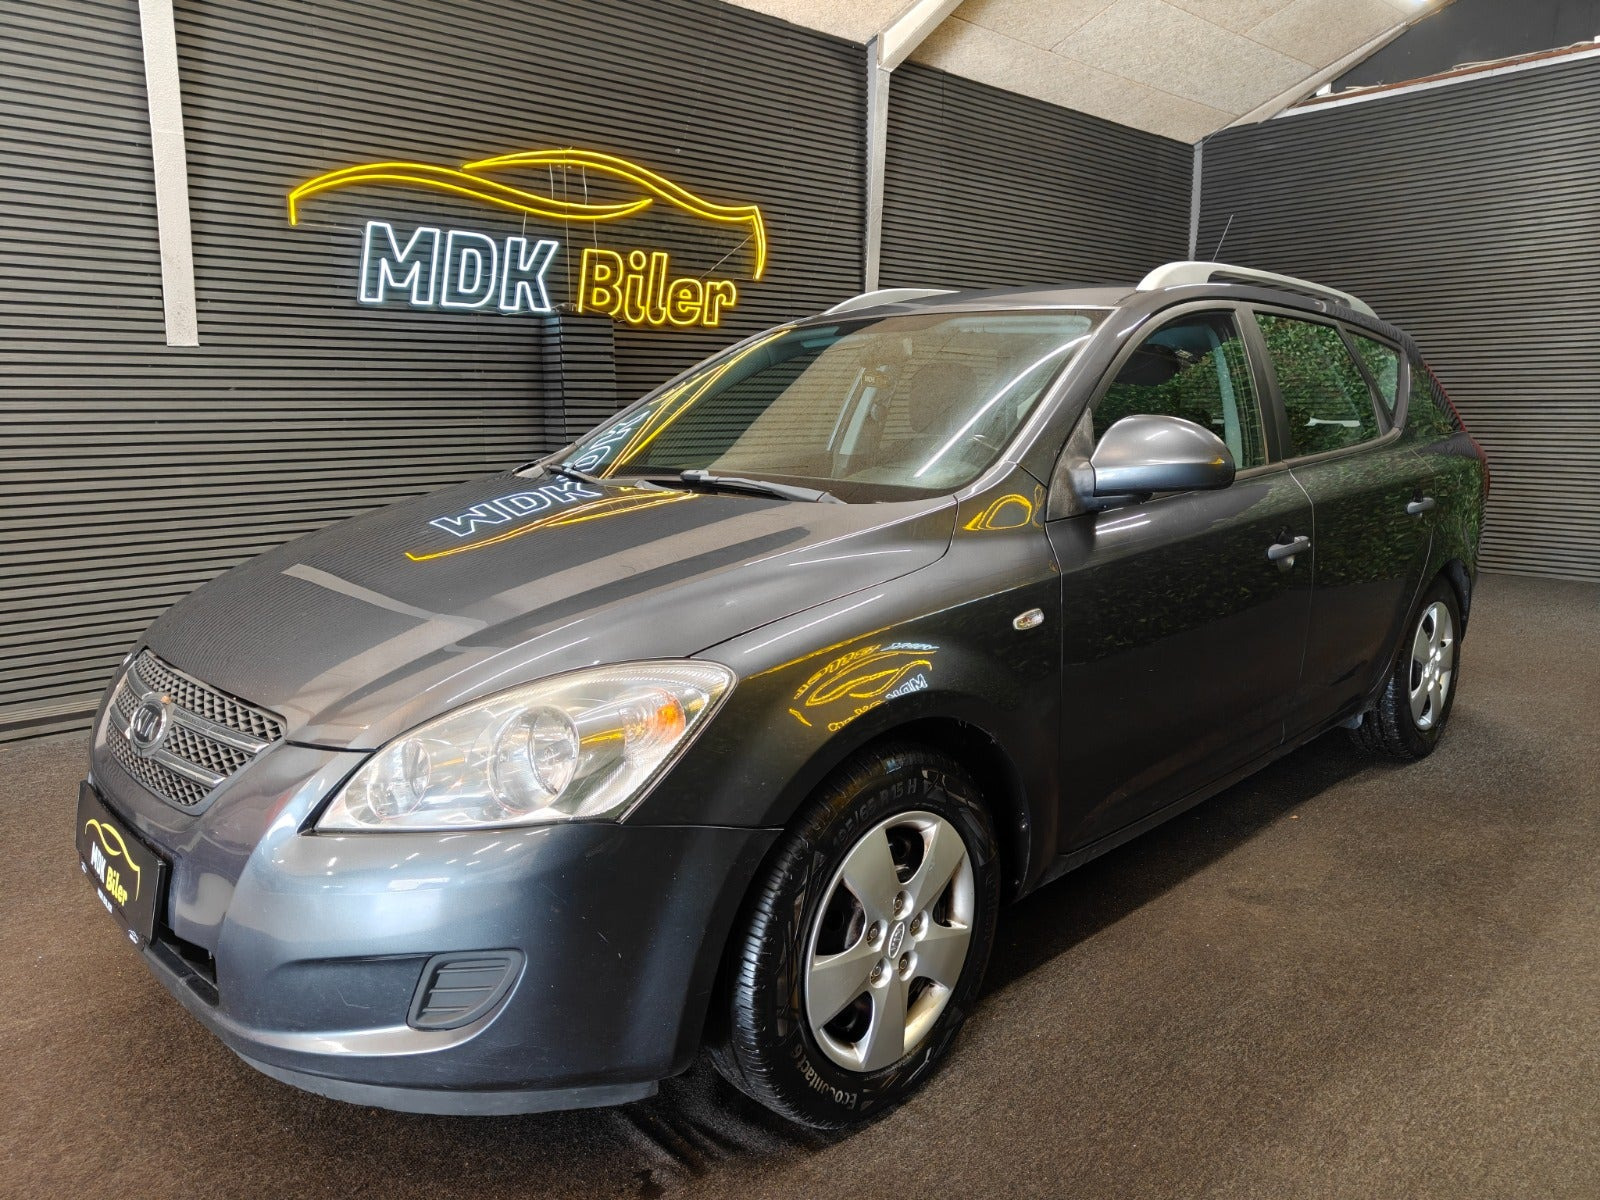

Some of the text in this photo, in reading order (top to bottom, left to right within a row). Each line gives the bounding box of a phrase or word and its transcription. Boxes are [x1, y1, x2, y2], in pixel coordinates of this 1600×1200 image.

[358, 220, 737, 327] MDK Biler
[106, 865, 128, 907] Biler
